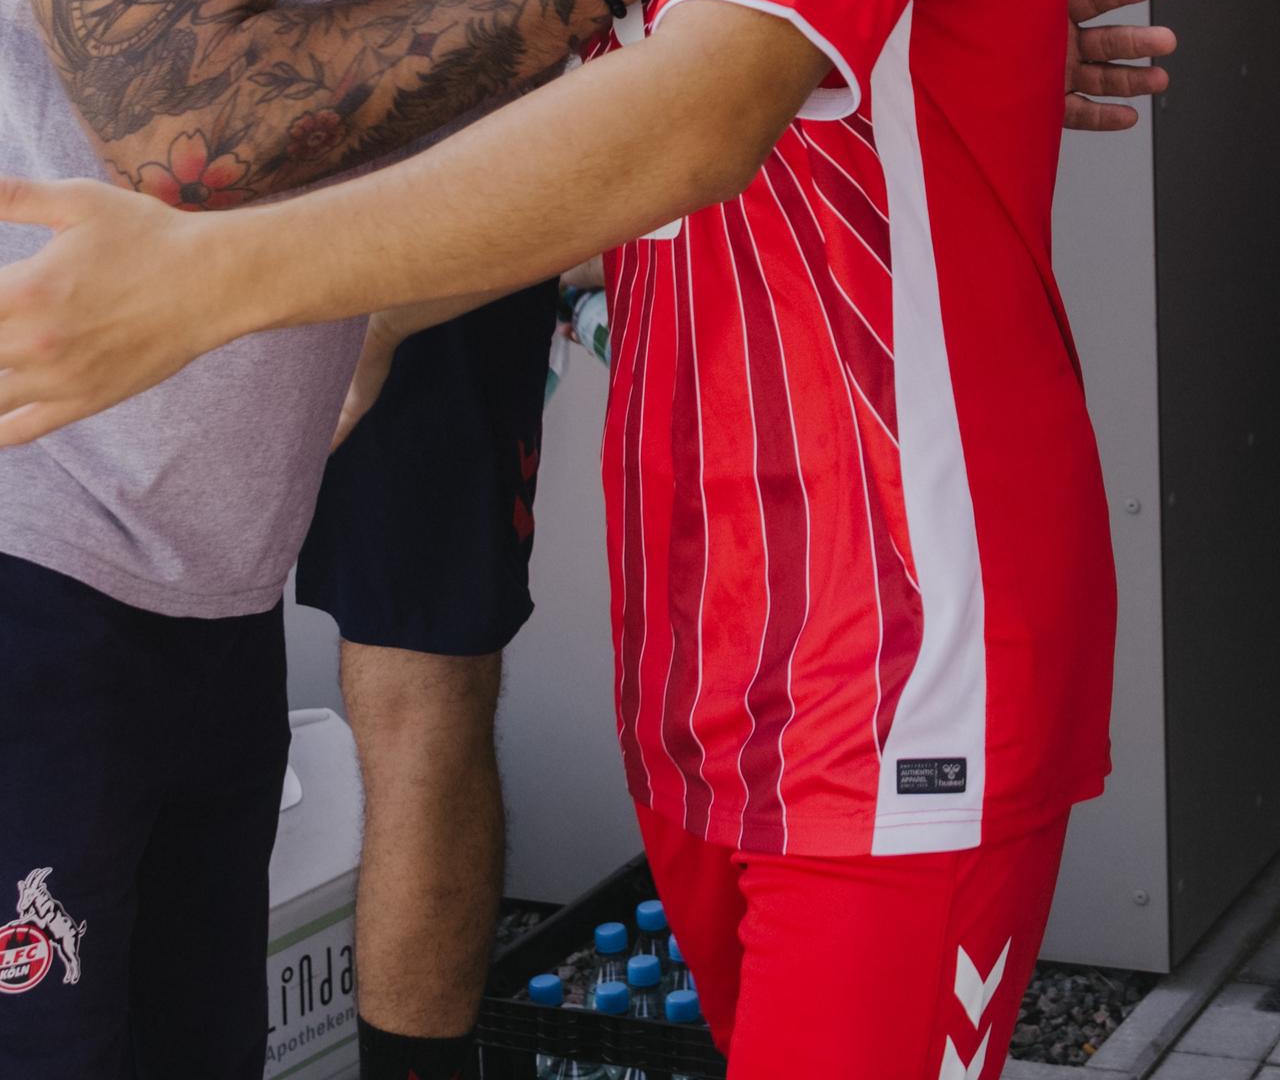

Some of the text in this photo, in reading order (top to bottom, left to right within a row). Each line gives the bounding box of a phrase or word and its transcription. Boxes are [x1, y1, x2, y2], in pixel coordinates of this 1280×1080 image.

[0, 963, 31, 981] KÖLN
[269, 945, 354, 1033] inda
[266, 1006, 356, 1063] Apotheken
